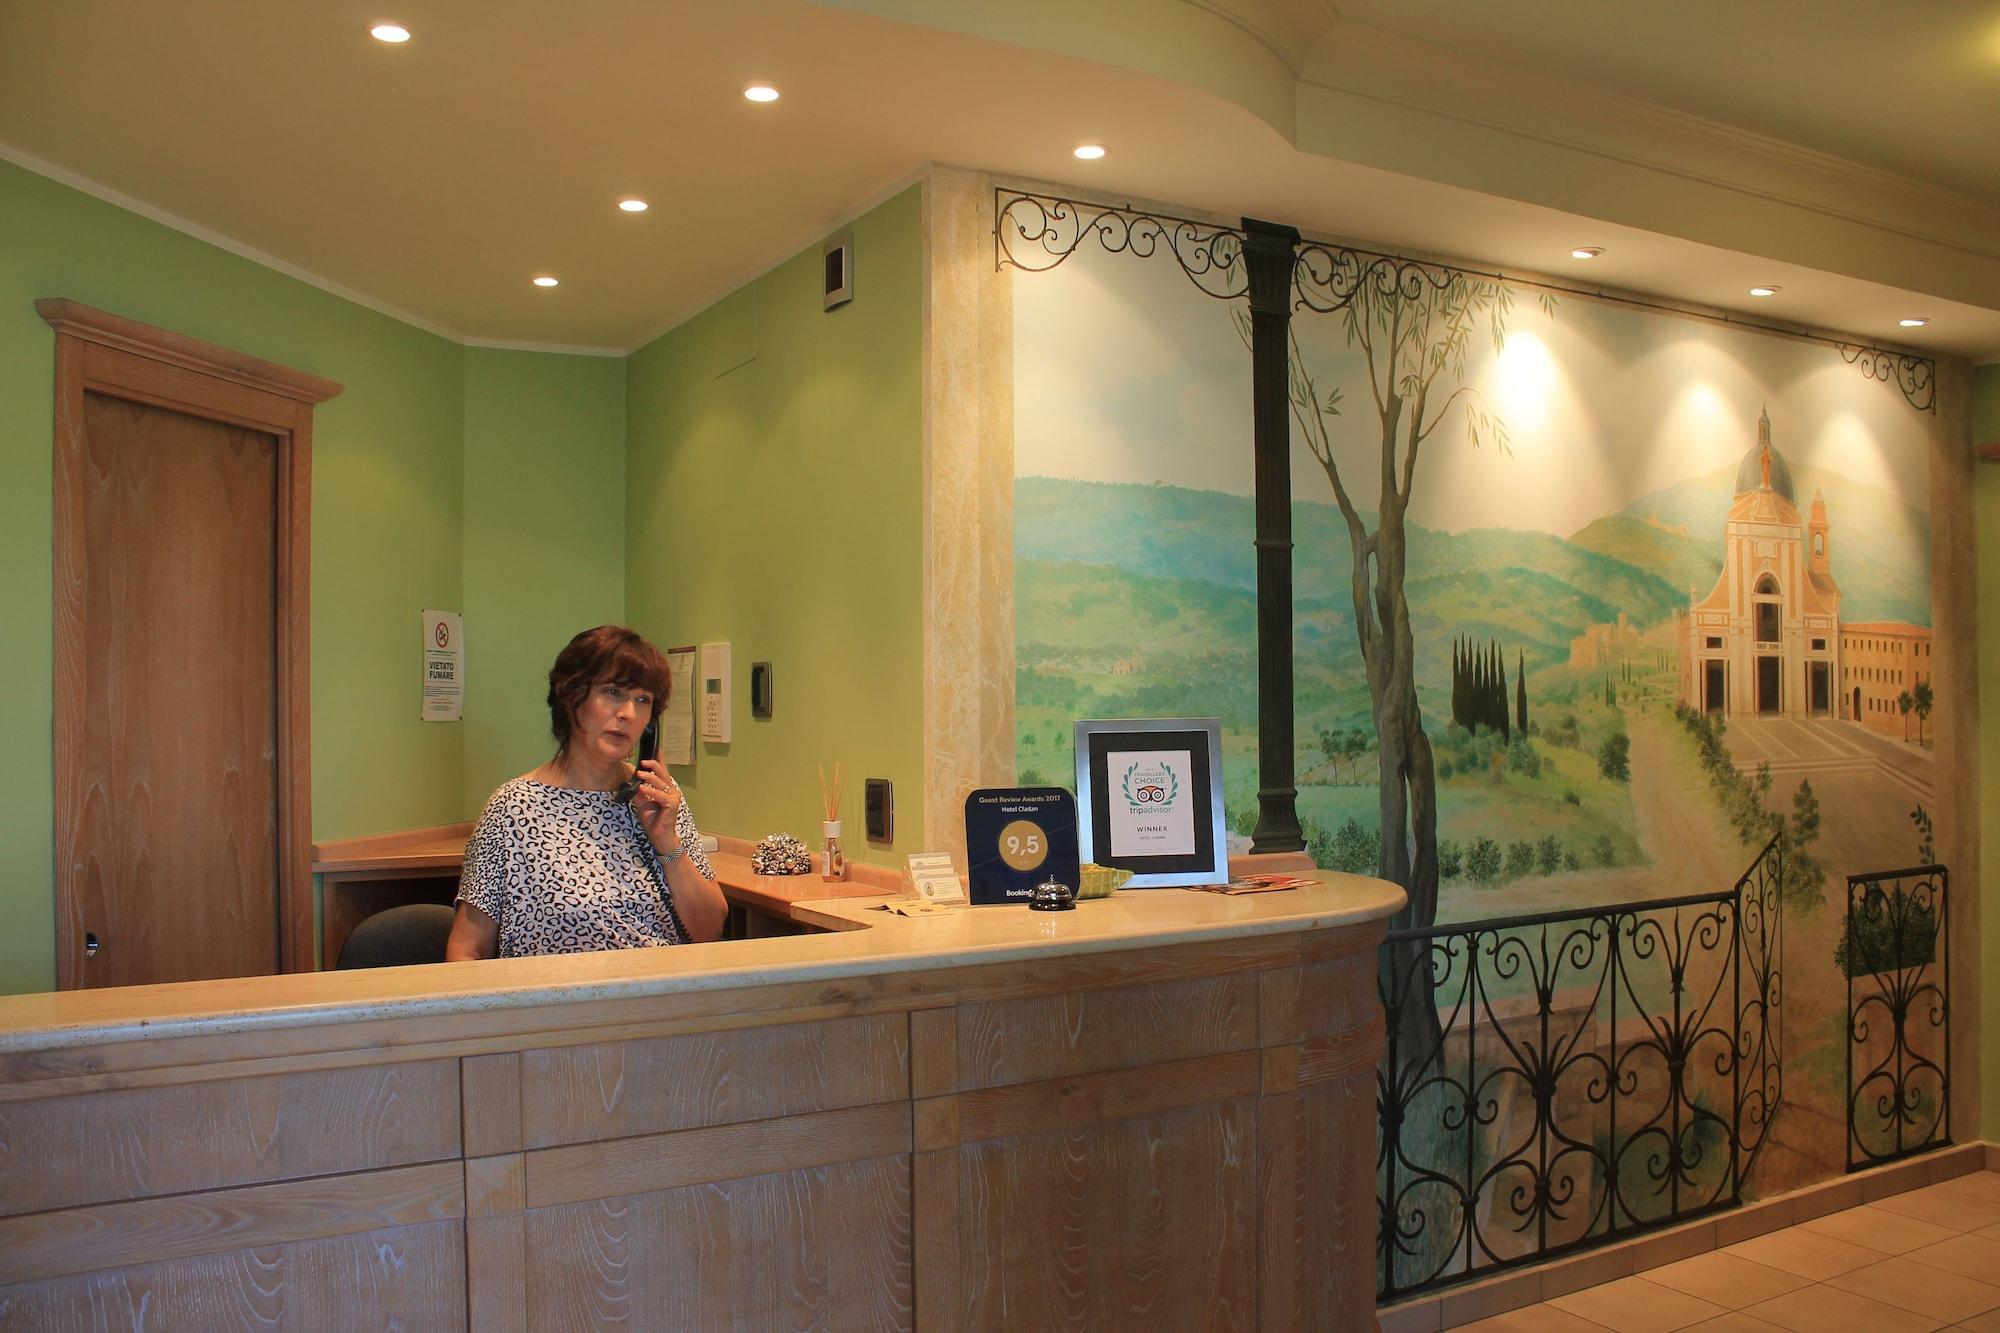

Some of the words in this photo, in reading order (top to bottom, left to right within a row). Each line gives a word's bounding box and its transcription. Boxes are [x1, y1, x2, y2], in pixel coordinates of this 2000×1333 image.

[429, 661, 454, 671] VIETATO
[429, 670, 454, 680] FUMARE
[979, 796, 998, 804] Guest
[1022, 795, 1045, 803] Awards
[1129, 806, 1171, 815] tripadvisor
[1136, 825, 1168, 833] WINNER
[1006, 835, 1040, 857] 9,5
[1006, 889, 1033, 897] Booking
